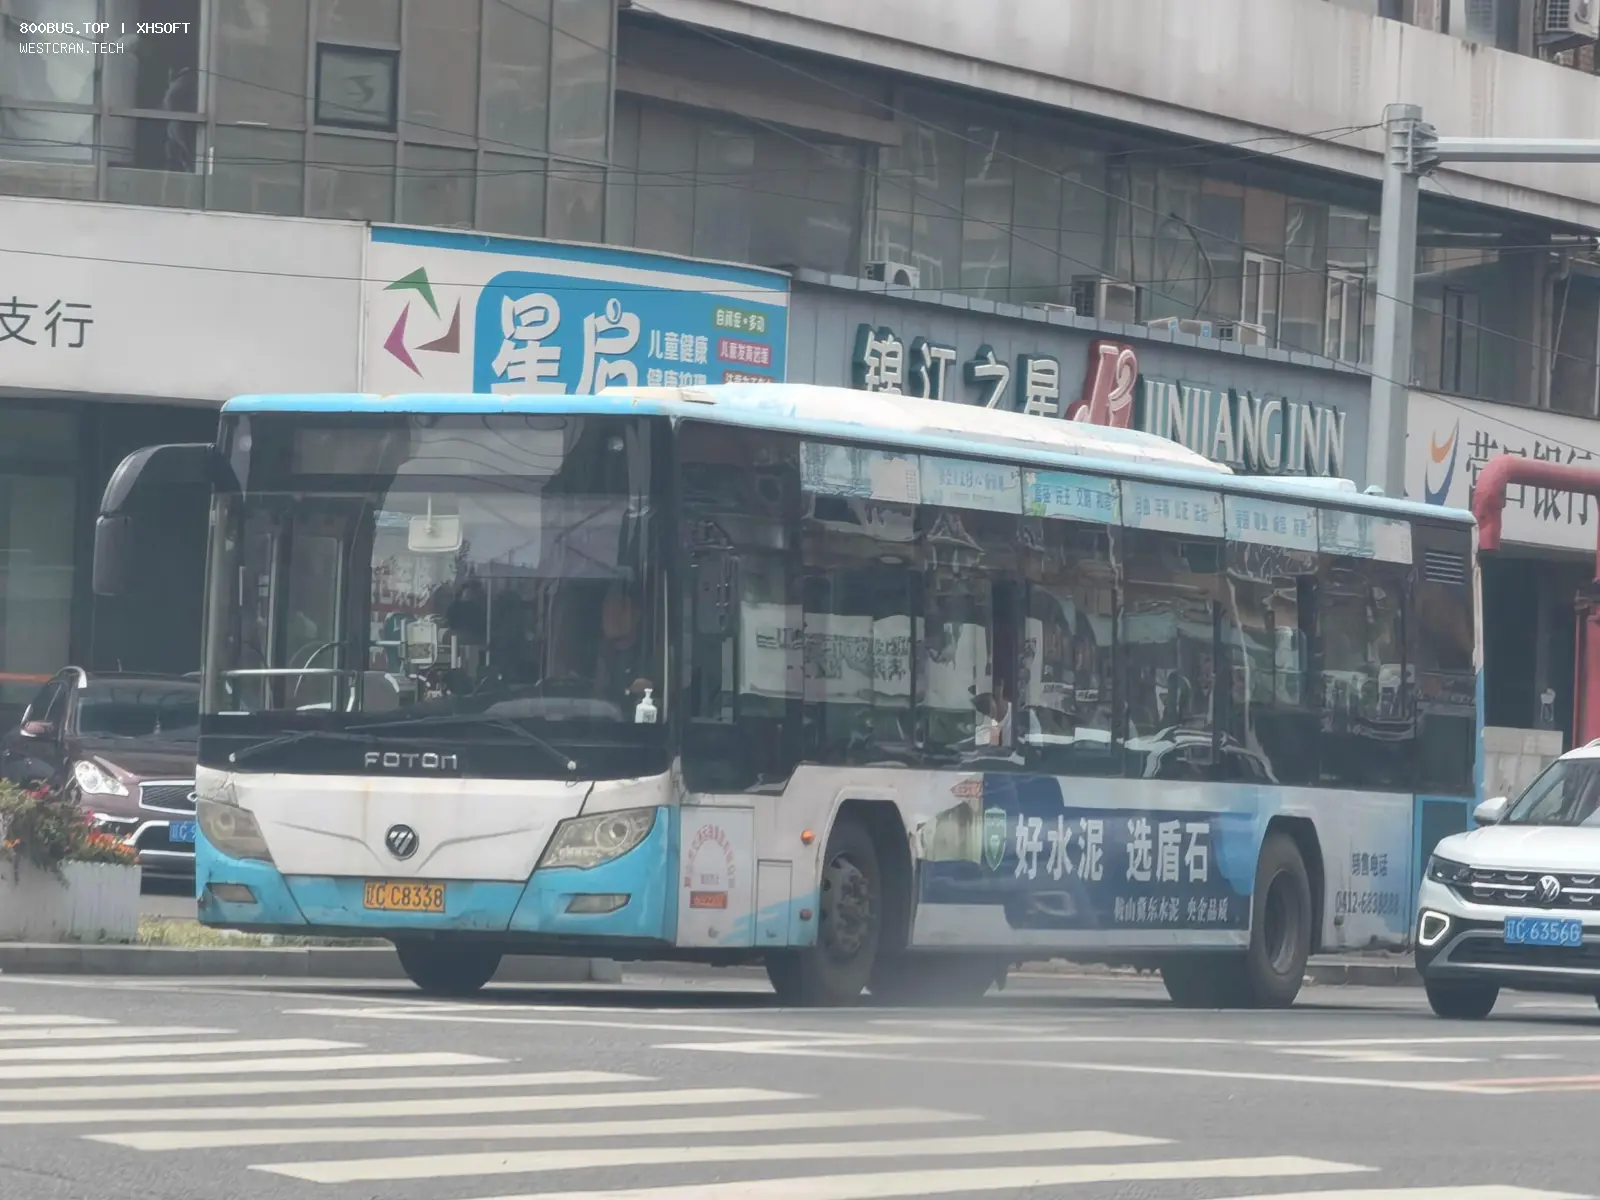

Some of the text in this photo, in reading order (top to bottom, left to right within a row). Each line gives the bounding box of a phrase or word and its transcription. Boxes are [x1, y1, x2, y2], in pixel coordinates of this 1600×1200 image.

[0, 296, 94, 348] 支行
[647, 329, 709, 364] 儿童健康
[863, 331, 1060, 416] 锦江之星
[364, 752, 458, 770] FOTON
[1015, 813, 1210, 883] 好水泥 选盾石
